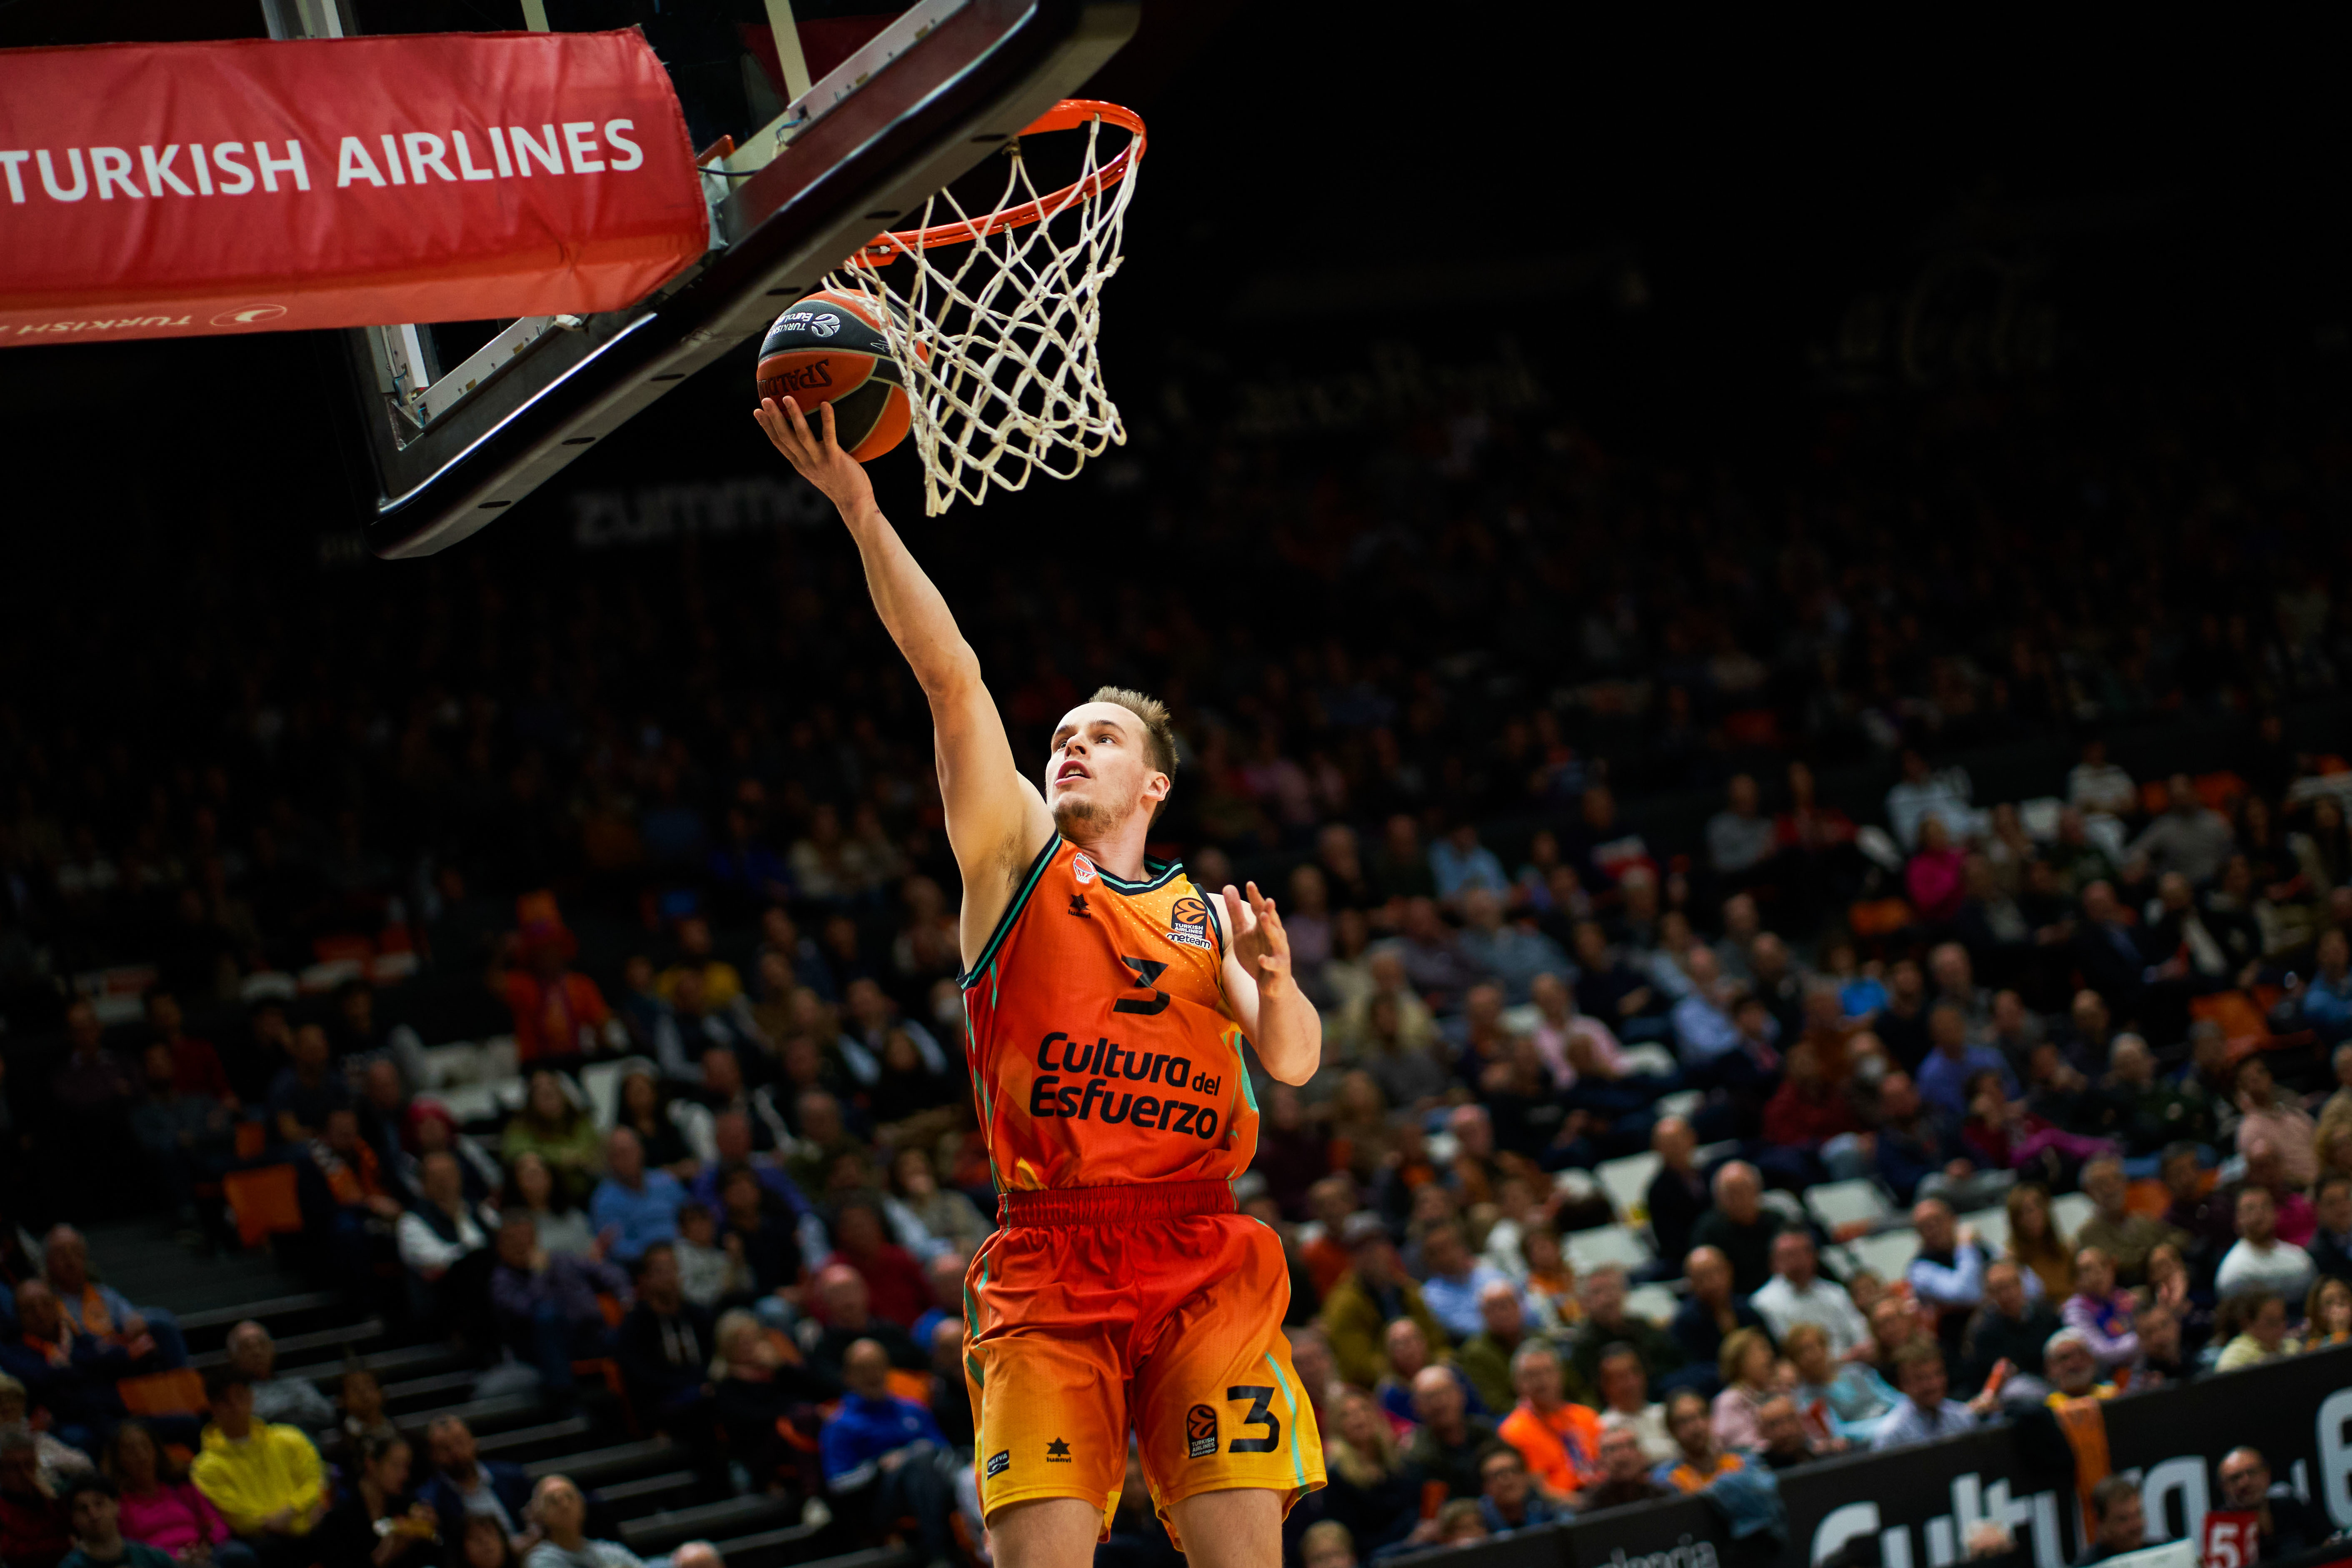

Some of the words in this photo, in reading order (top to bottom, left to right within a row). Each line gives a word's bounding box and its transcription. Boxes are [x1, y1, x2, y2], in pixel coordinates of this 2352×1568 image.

[0, 140, 311, 203] TURKISH
[337, 119, 644, 189] AIRLINES
[17, 315, 192, 334] TURKISH
[1167, 934, 1210, 949] oneteam
[1113, 955, 1171, 1016] 3
[1037, 1032, 1191, 1088] Cultura
[1192, 1072, 1221, 1096] del
[1029, 1075, 1218, 1140] Esfuerzo
[1227, 1386, 1280, 1453] 3
[988, 1453, 1007, 1468] PULEVA
[1192, 1437, 1215, 1447] TURKISH
[1192, 1442, 1215, 1452] AIRLINES
